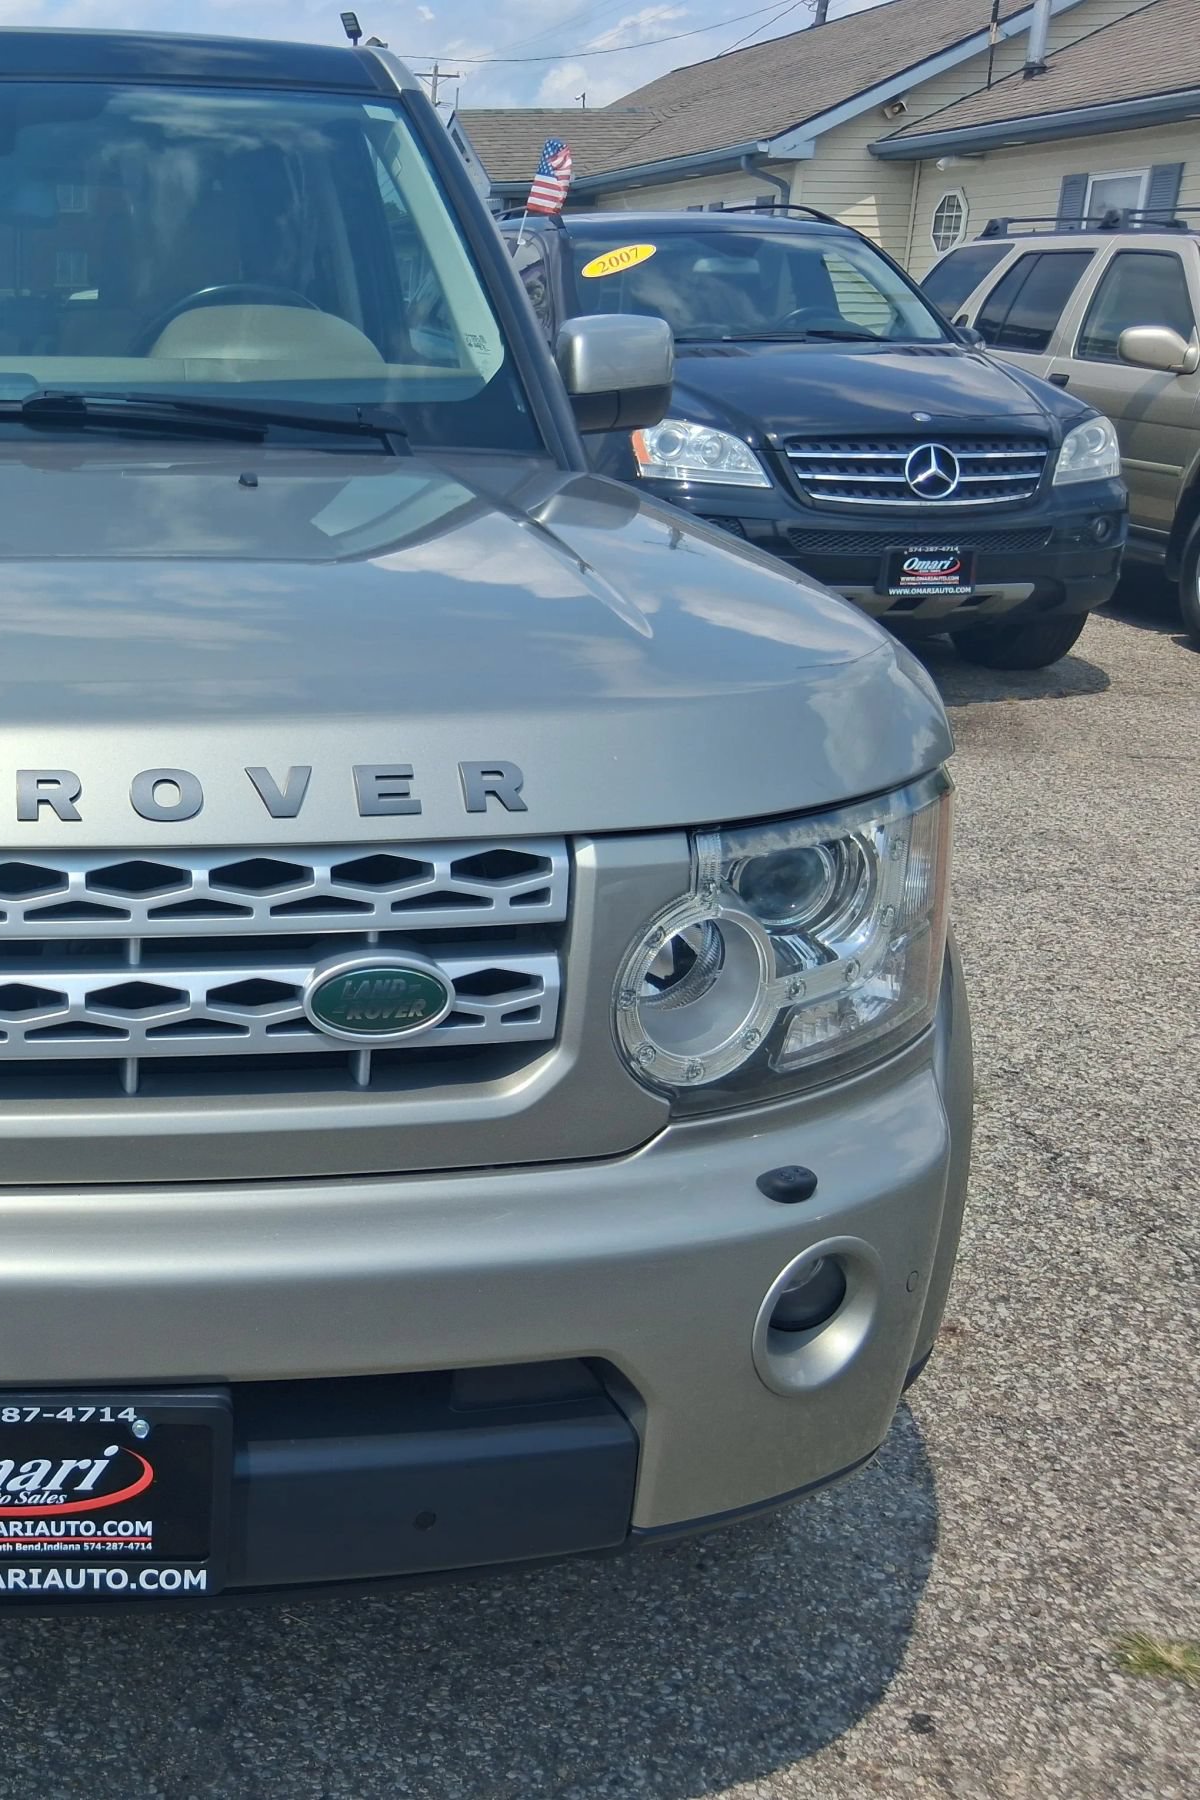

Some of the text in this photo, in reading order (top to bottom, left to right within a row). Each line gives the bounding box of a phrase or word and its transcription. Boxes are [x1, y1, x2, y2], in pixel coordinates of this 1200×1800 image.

[596, 247, 638, 273] 2007
[903, 557, 953, 570] Omari
[889, 587, 971, 595] WWW.OMARIAUTO.COM
[17, 760, 528, 823] ROVER
[340, 978, 408, 999] LAND
[346, 998, 427, 1020] ROVER
[14, 1491, 67, 1505] Sales
[83, 1542, 152, 1550] 574-287-4714
